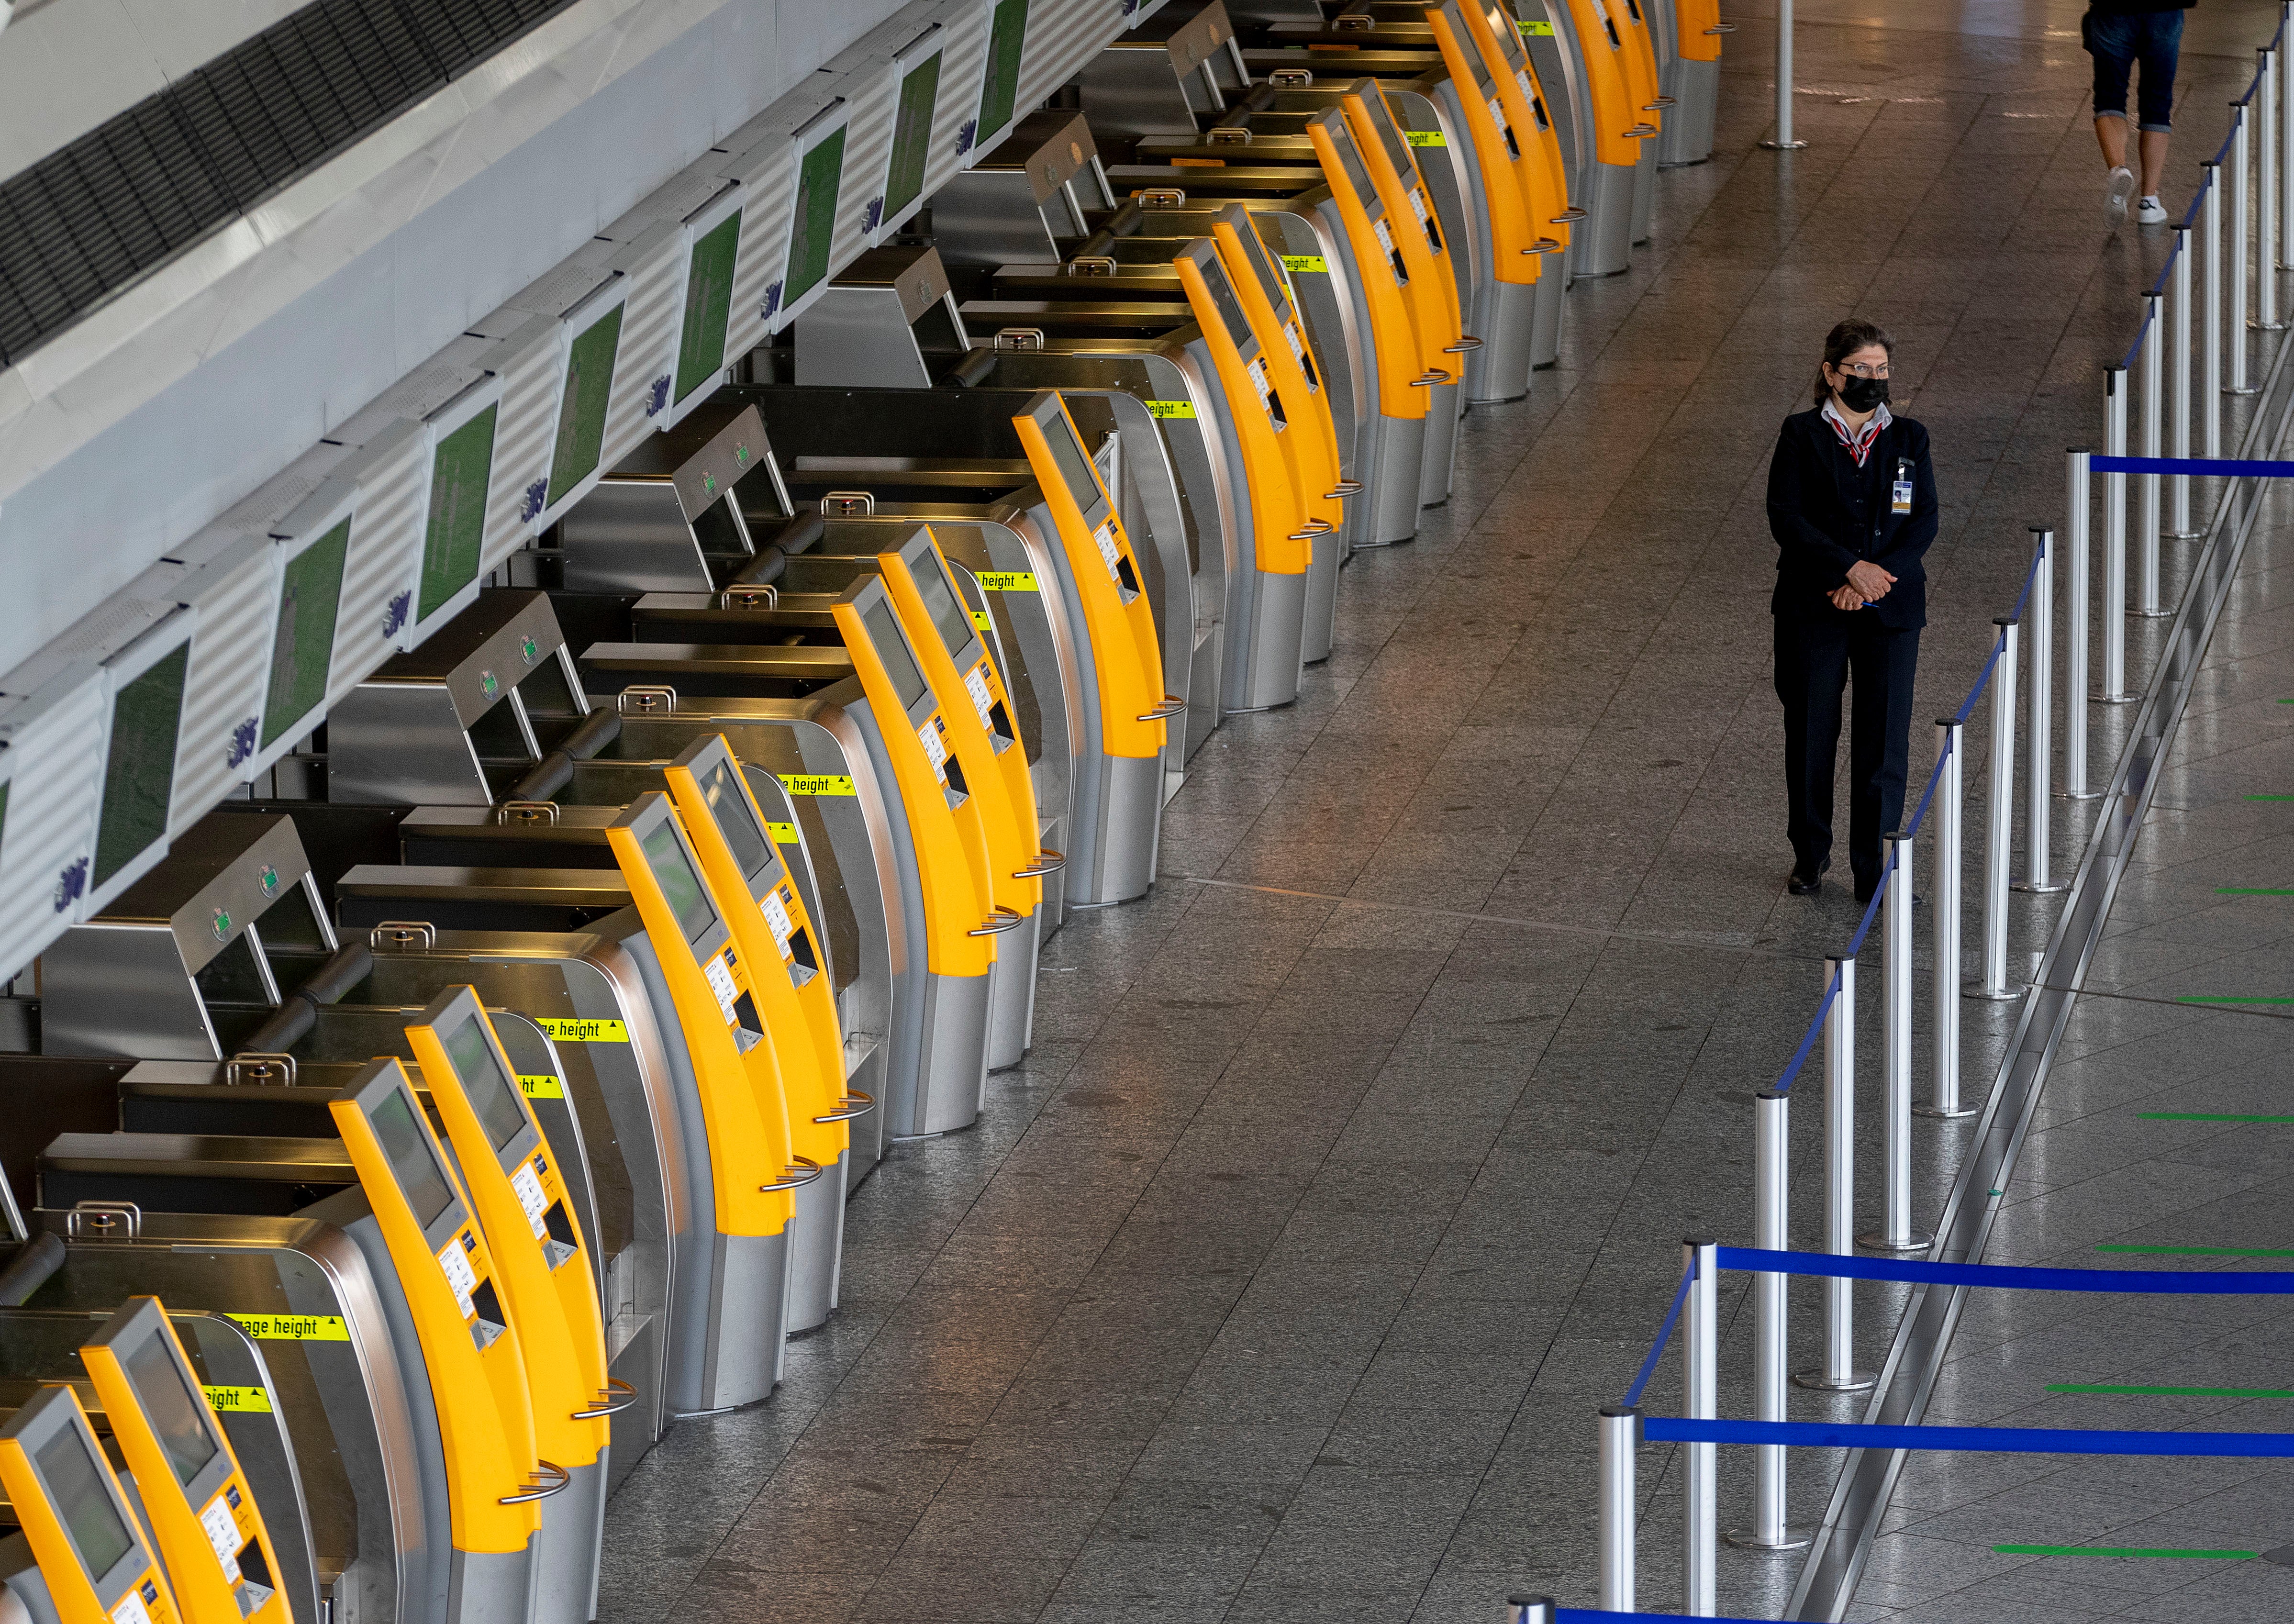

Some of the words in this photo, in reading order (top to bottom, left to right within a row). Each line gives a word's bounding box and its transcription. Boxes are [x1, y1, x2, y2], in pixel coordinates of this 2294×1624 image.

[982, 574, 1014, 590] height
[793, 777, 829, 794] height
[560, 1022, 599, 1040] height
[274, 1317, 317, 1338] height
